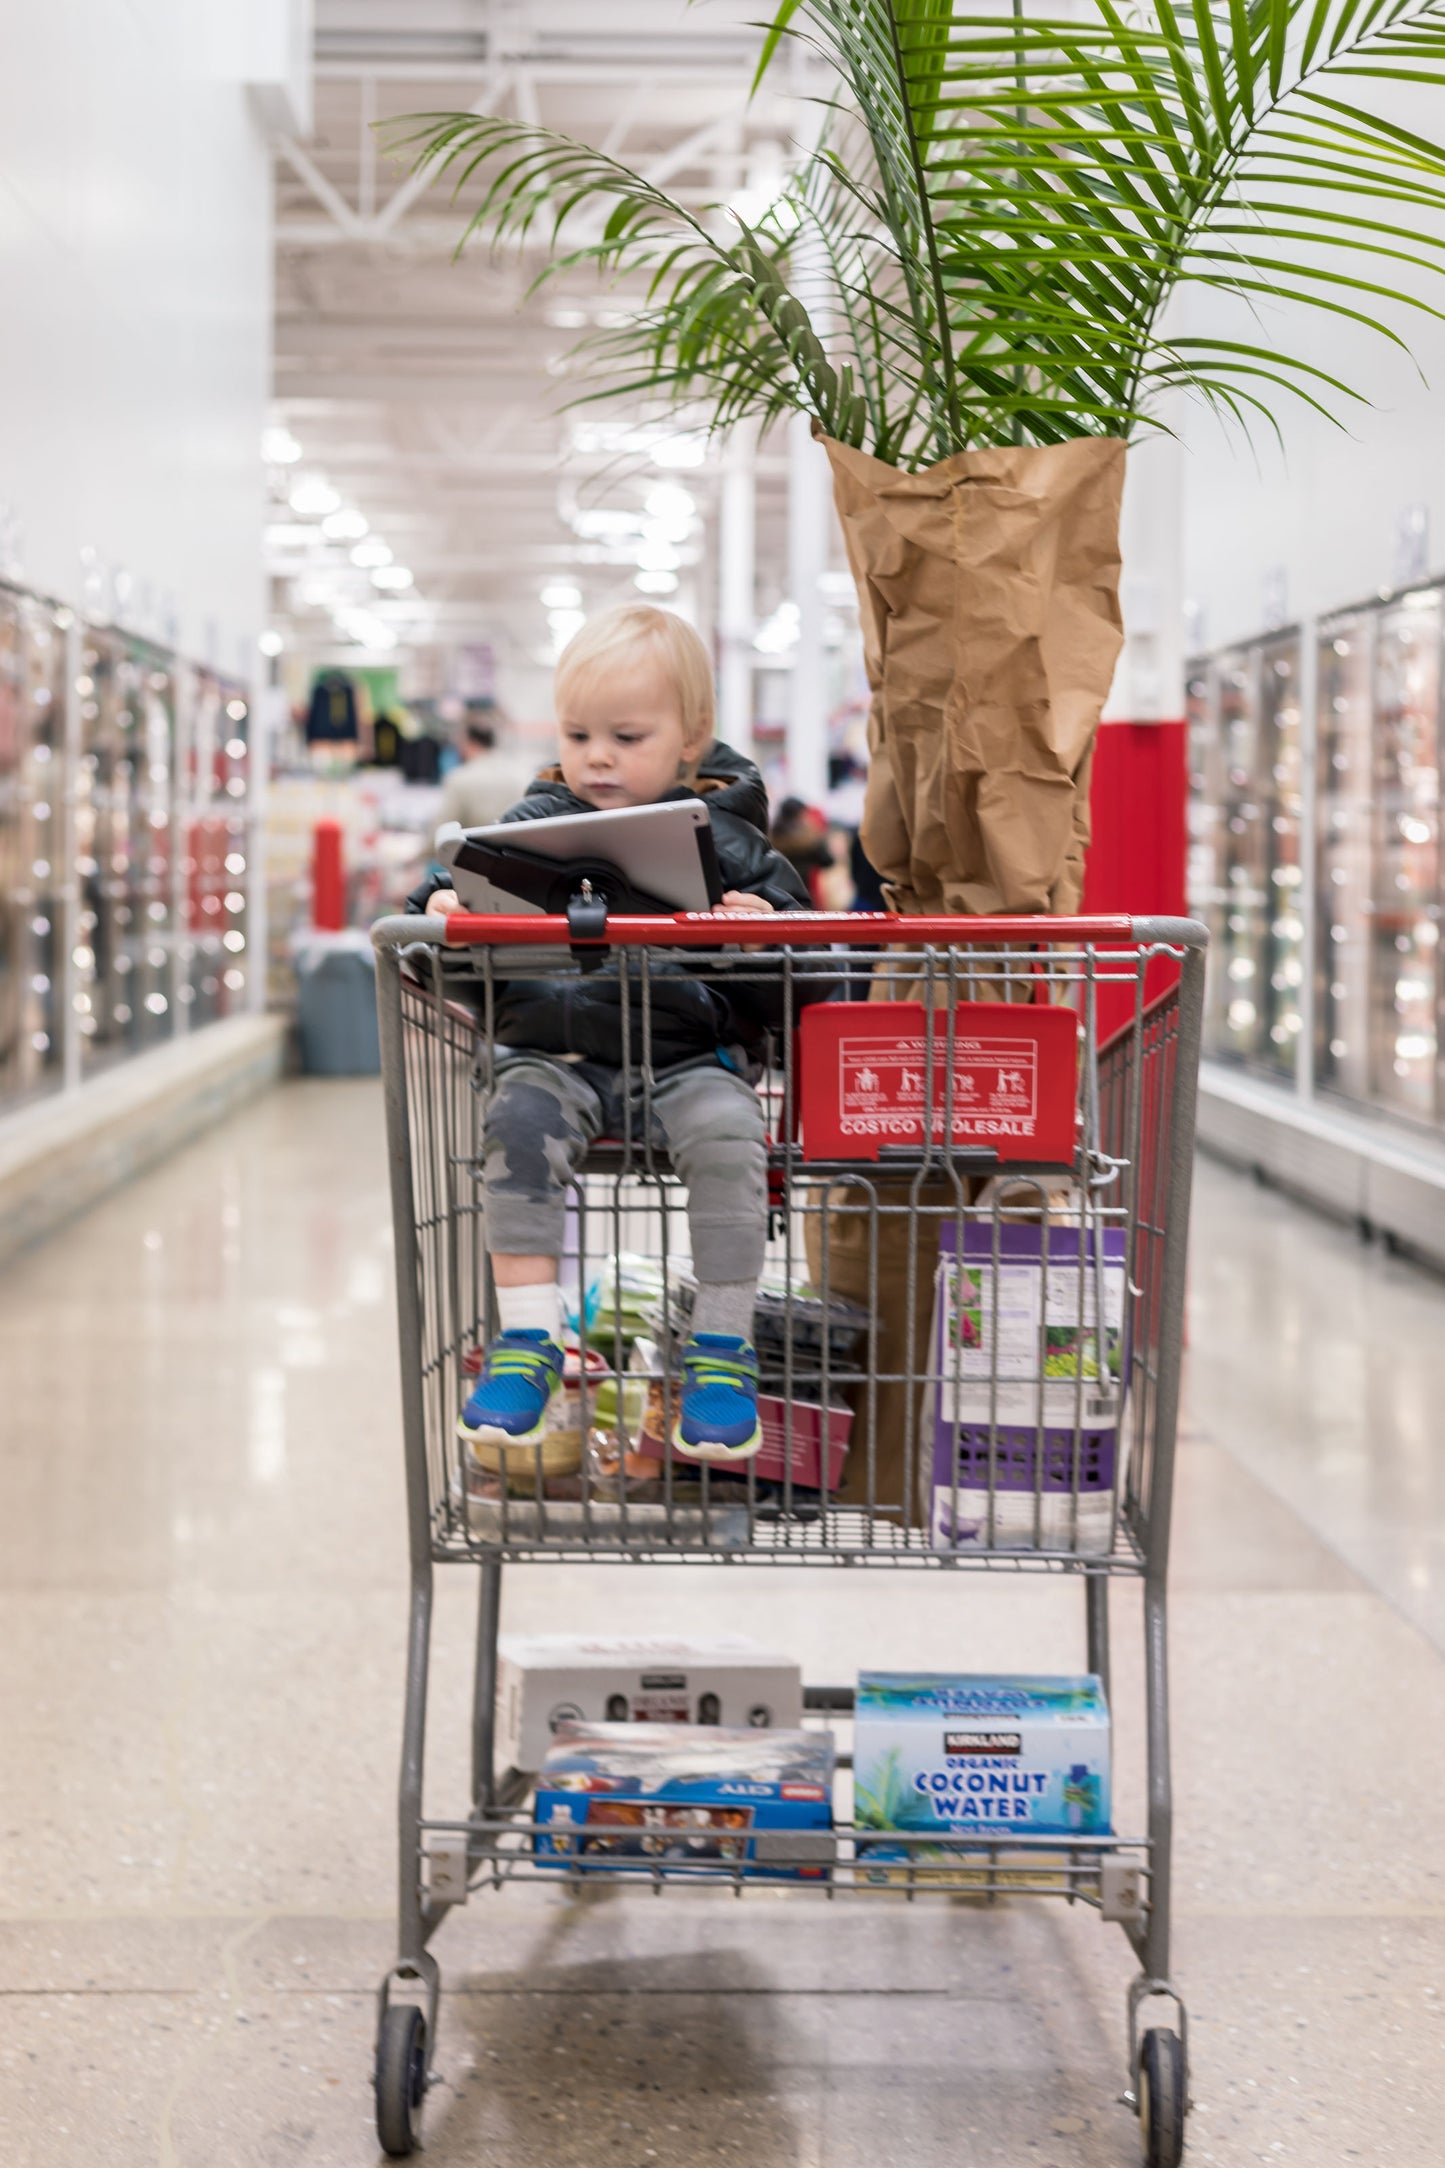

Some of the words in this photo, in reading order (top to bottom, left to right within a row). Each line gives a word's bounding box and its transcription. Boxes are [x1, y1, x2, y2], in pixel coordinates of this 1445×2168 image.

[839, 1119, 917, 1135] COSTCO
[946, 1733, 1020, 1748] KIRKLAND
[946, 1757, 1019, 1769] ORGANIC
[914, 1773, 1048, 1793] COCONUT
[933, 1798, 1030, 1818] WATER
